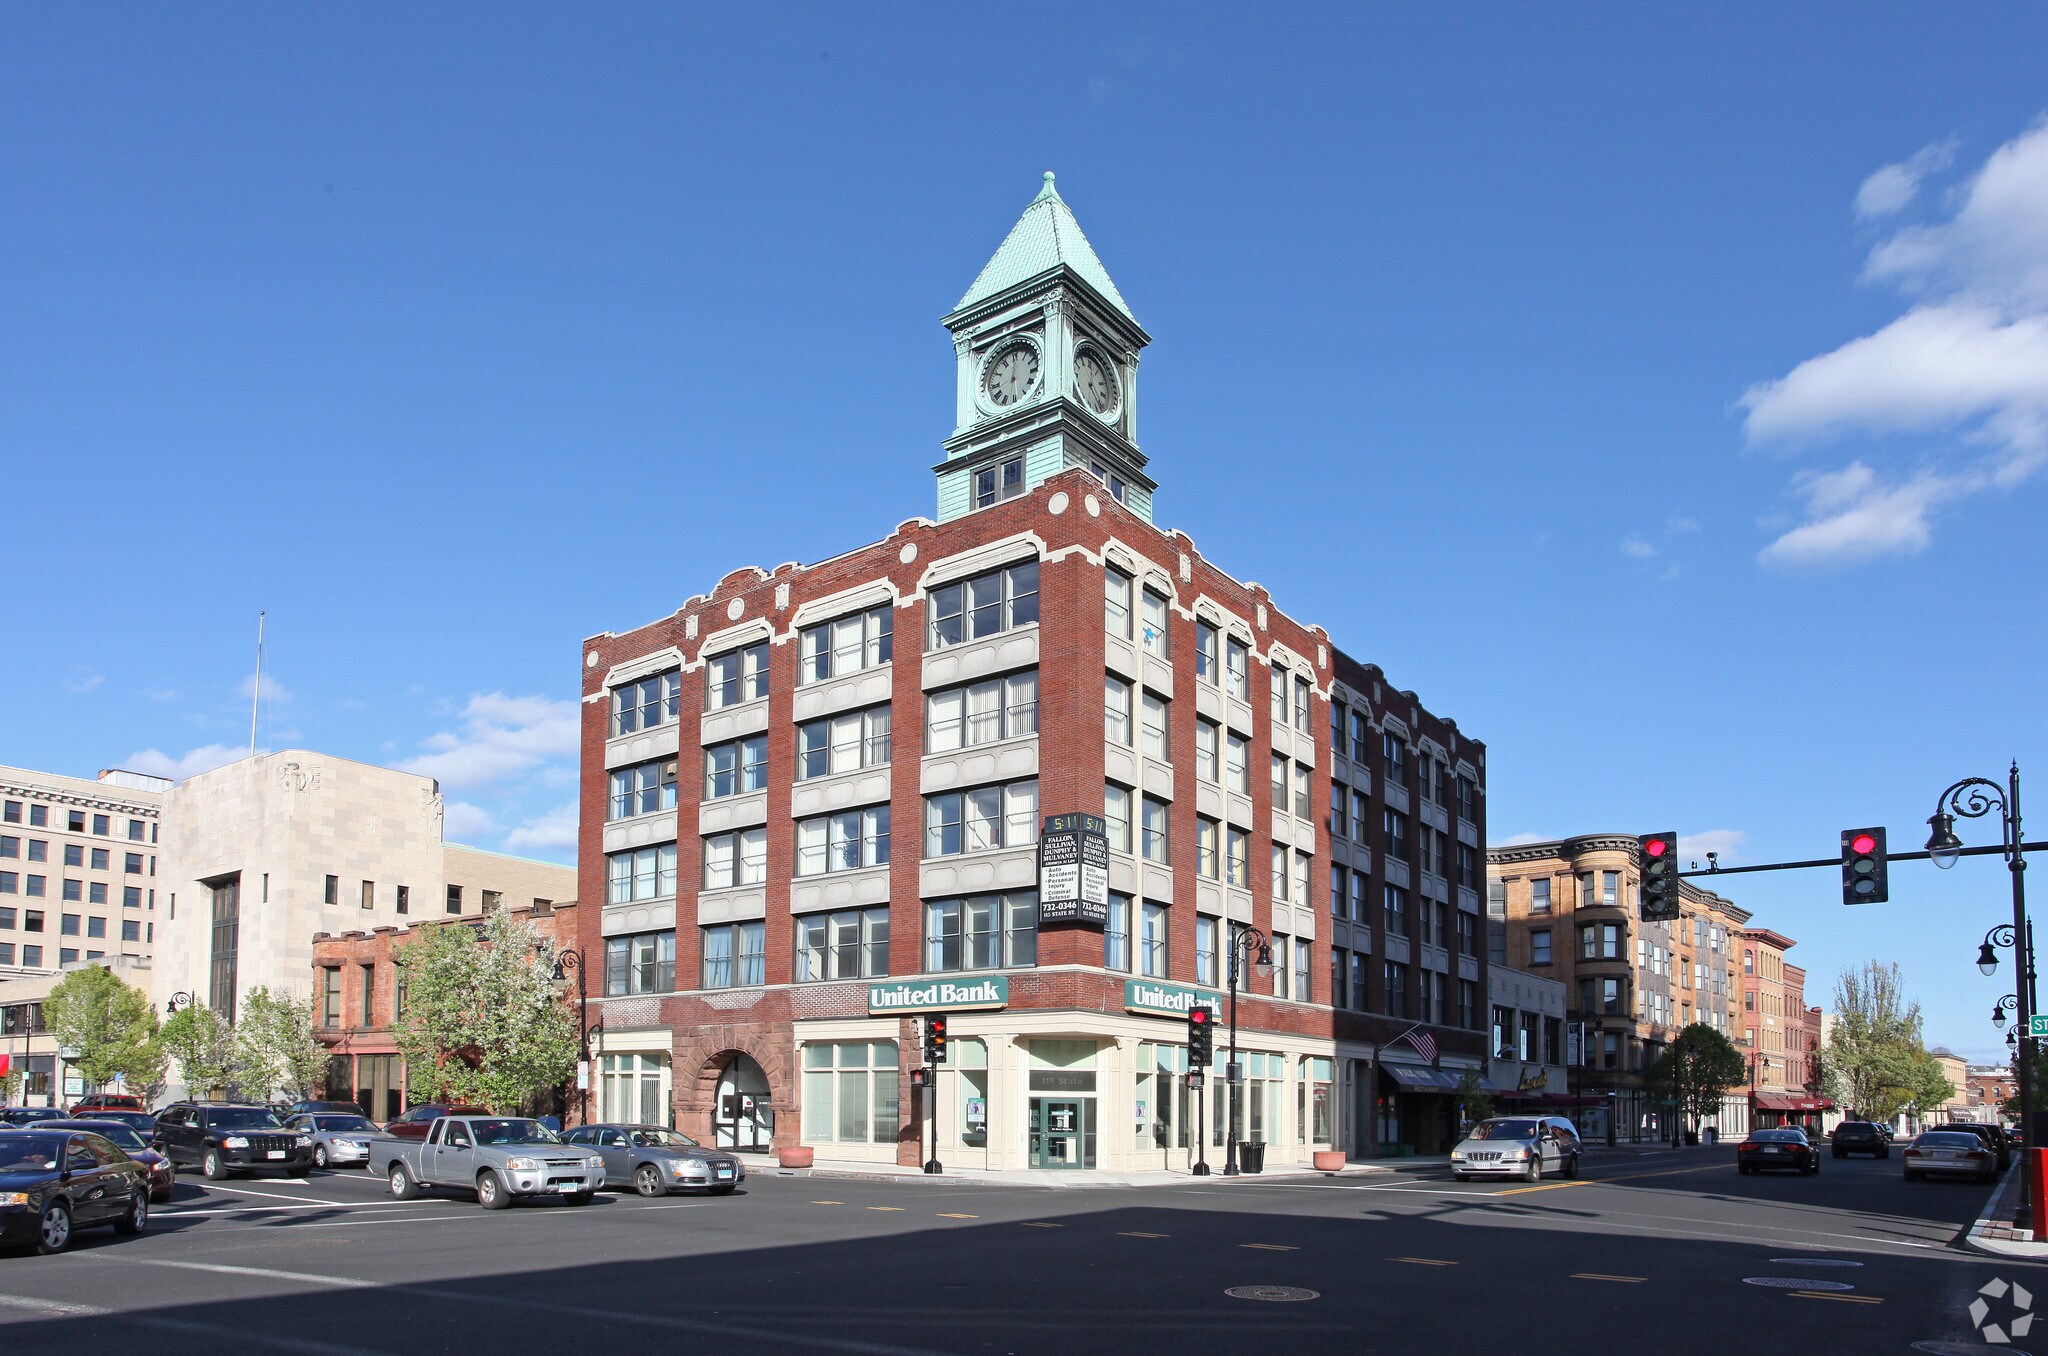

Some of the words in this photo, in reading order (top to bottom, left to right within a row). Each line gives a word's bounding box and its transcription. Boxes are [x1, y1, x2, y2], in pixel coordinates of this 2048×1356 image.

[1054, 816, 1076, 830] 5:11
[1086, 818, 1102, 832] 5:11
[1043, 852, 1078, 862] MULVANEY
[1044, 847, 1071, 856] DUNPHY
[1043, 902, 1076, 911] 732-0346
[1082, 902, 1106, 913] 732-0346
[871, 985, 939, 1007] United
[940, 980, 1000, 1003] Bank
[1133, 985, 1184, 1010] United
[1042, 1077, 1055, 1085] 115
[1058, 1077, 1083, 1085] State
